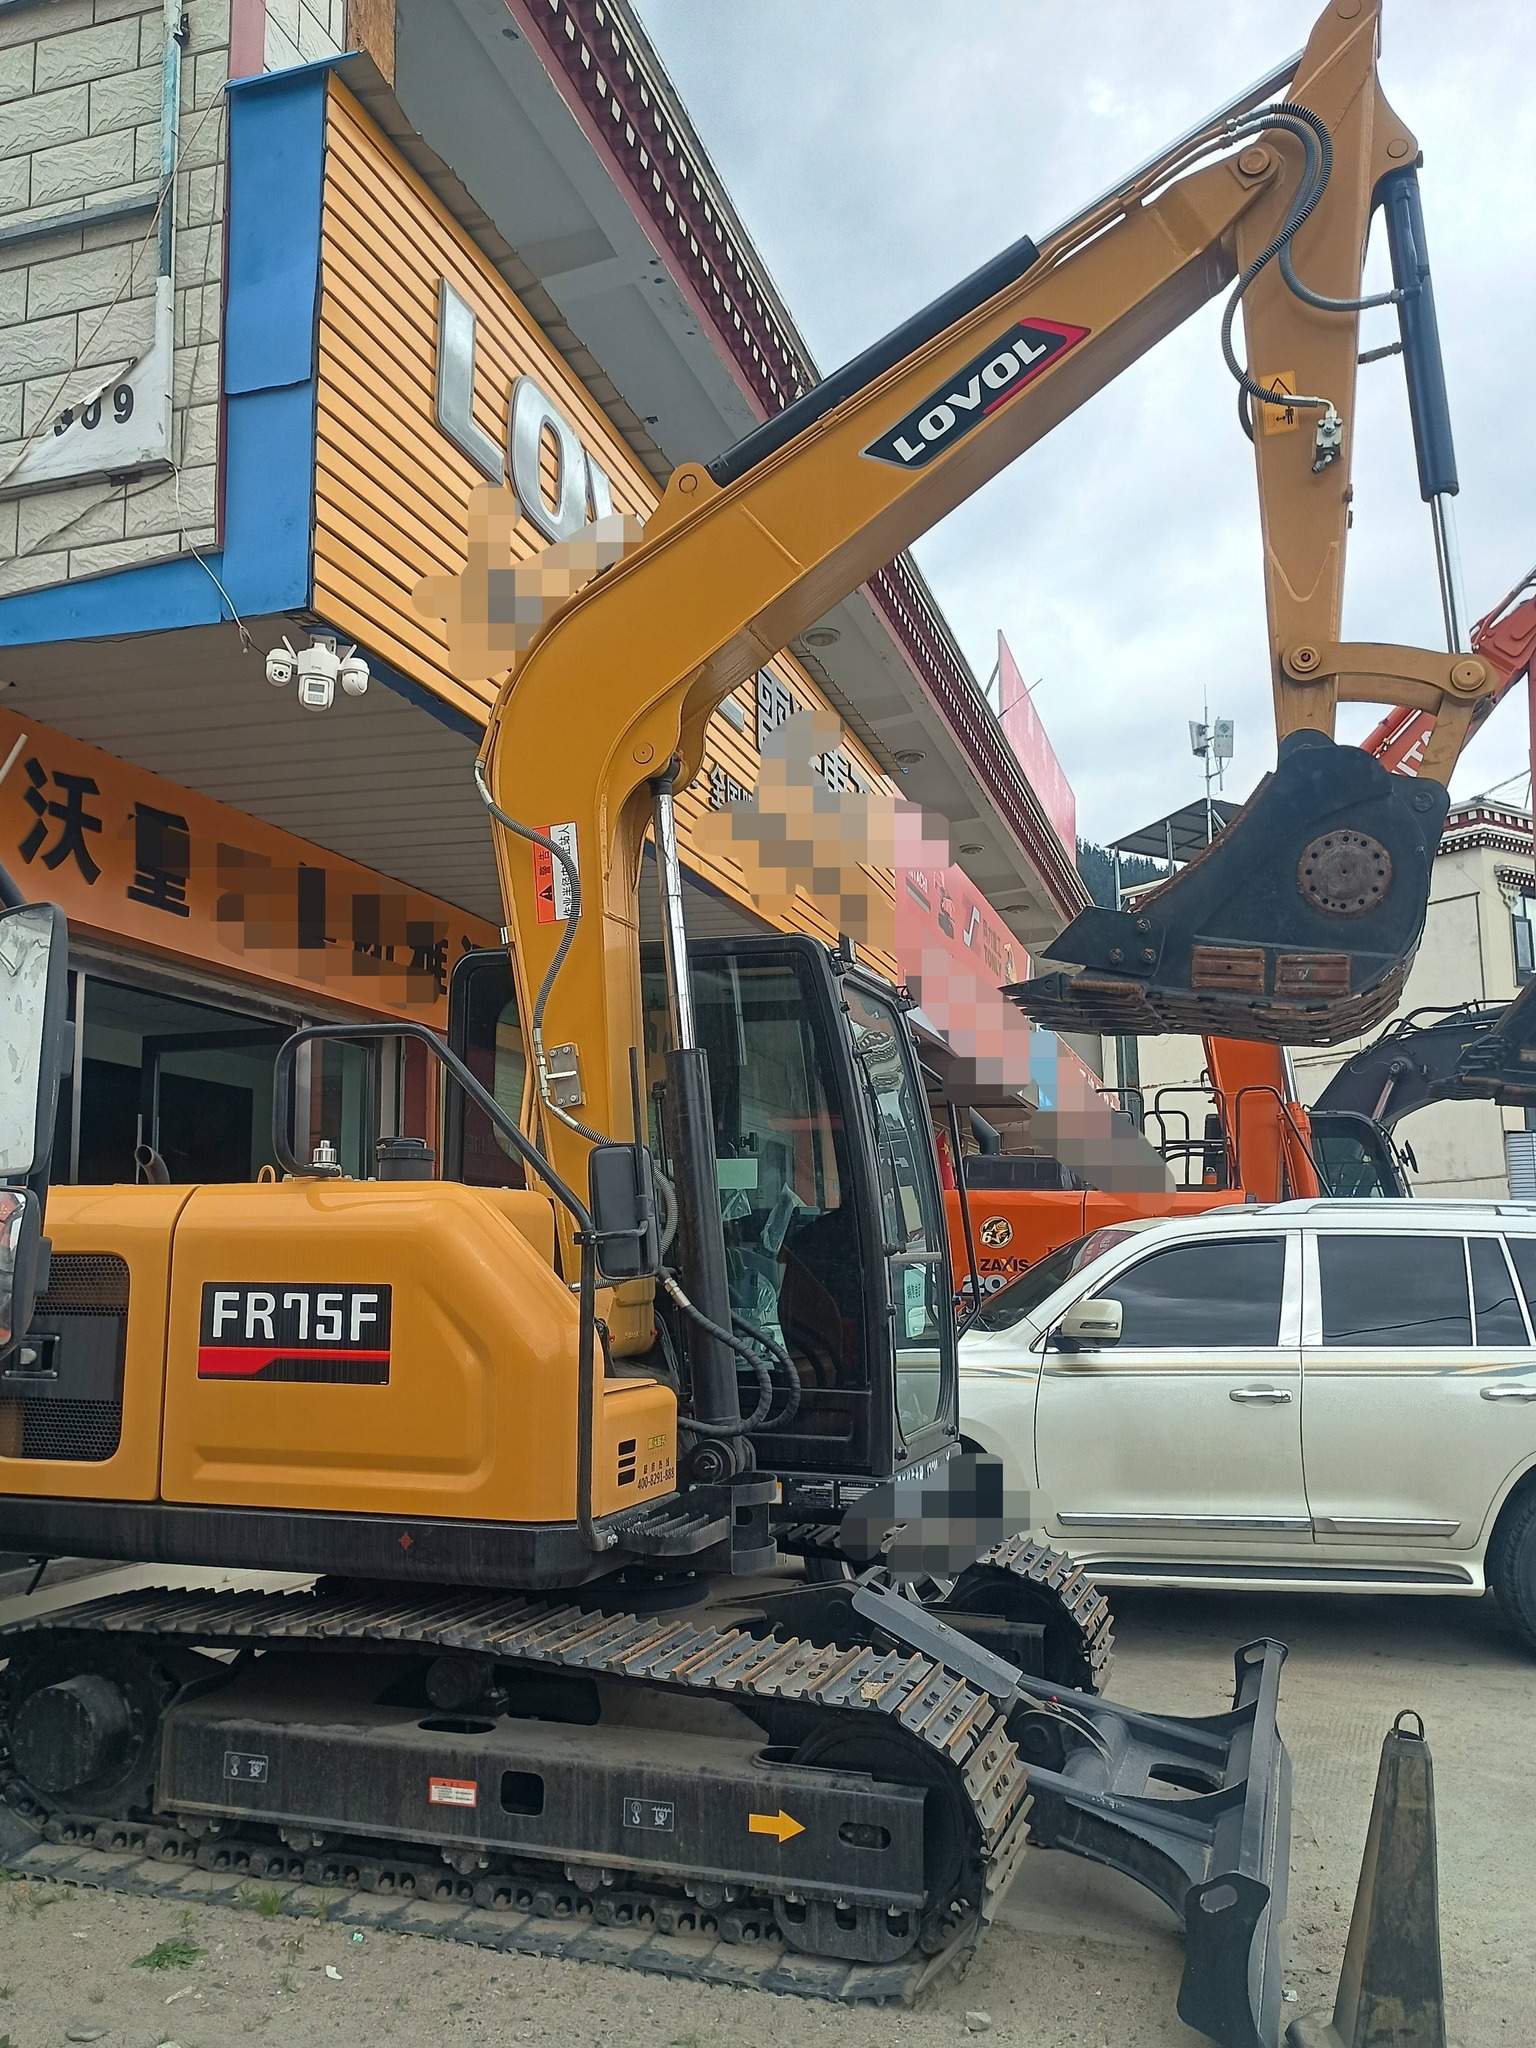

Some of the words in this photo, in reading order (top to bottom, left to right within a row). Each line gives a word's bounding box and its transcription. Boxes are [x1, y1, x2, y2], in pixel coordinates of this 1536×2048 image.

[892, 338, 1047, 462] LOVOL
[980, 1256, 1030, 1272] ZAXIS
[212, 1291, 379, 1342] FR75F
